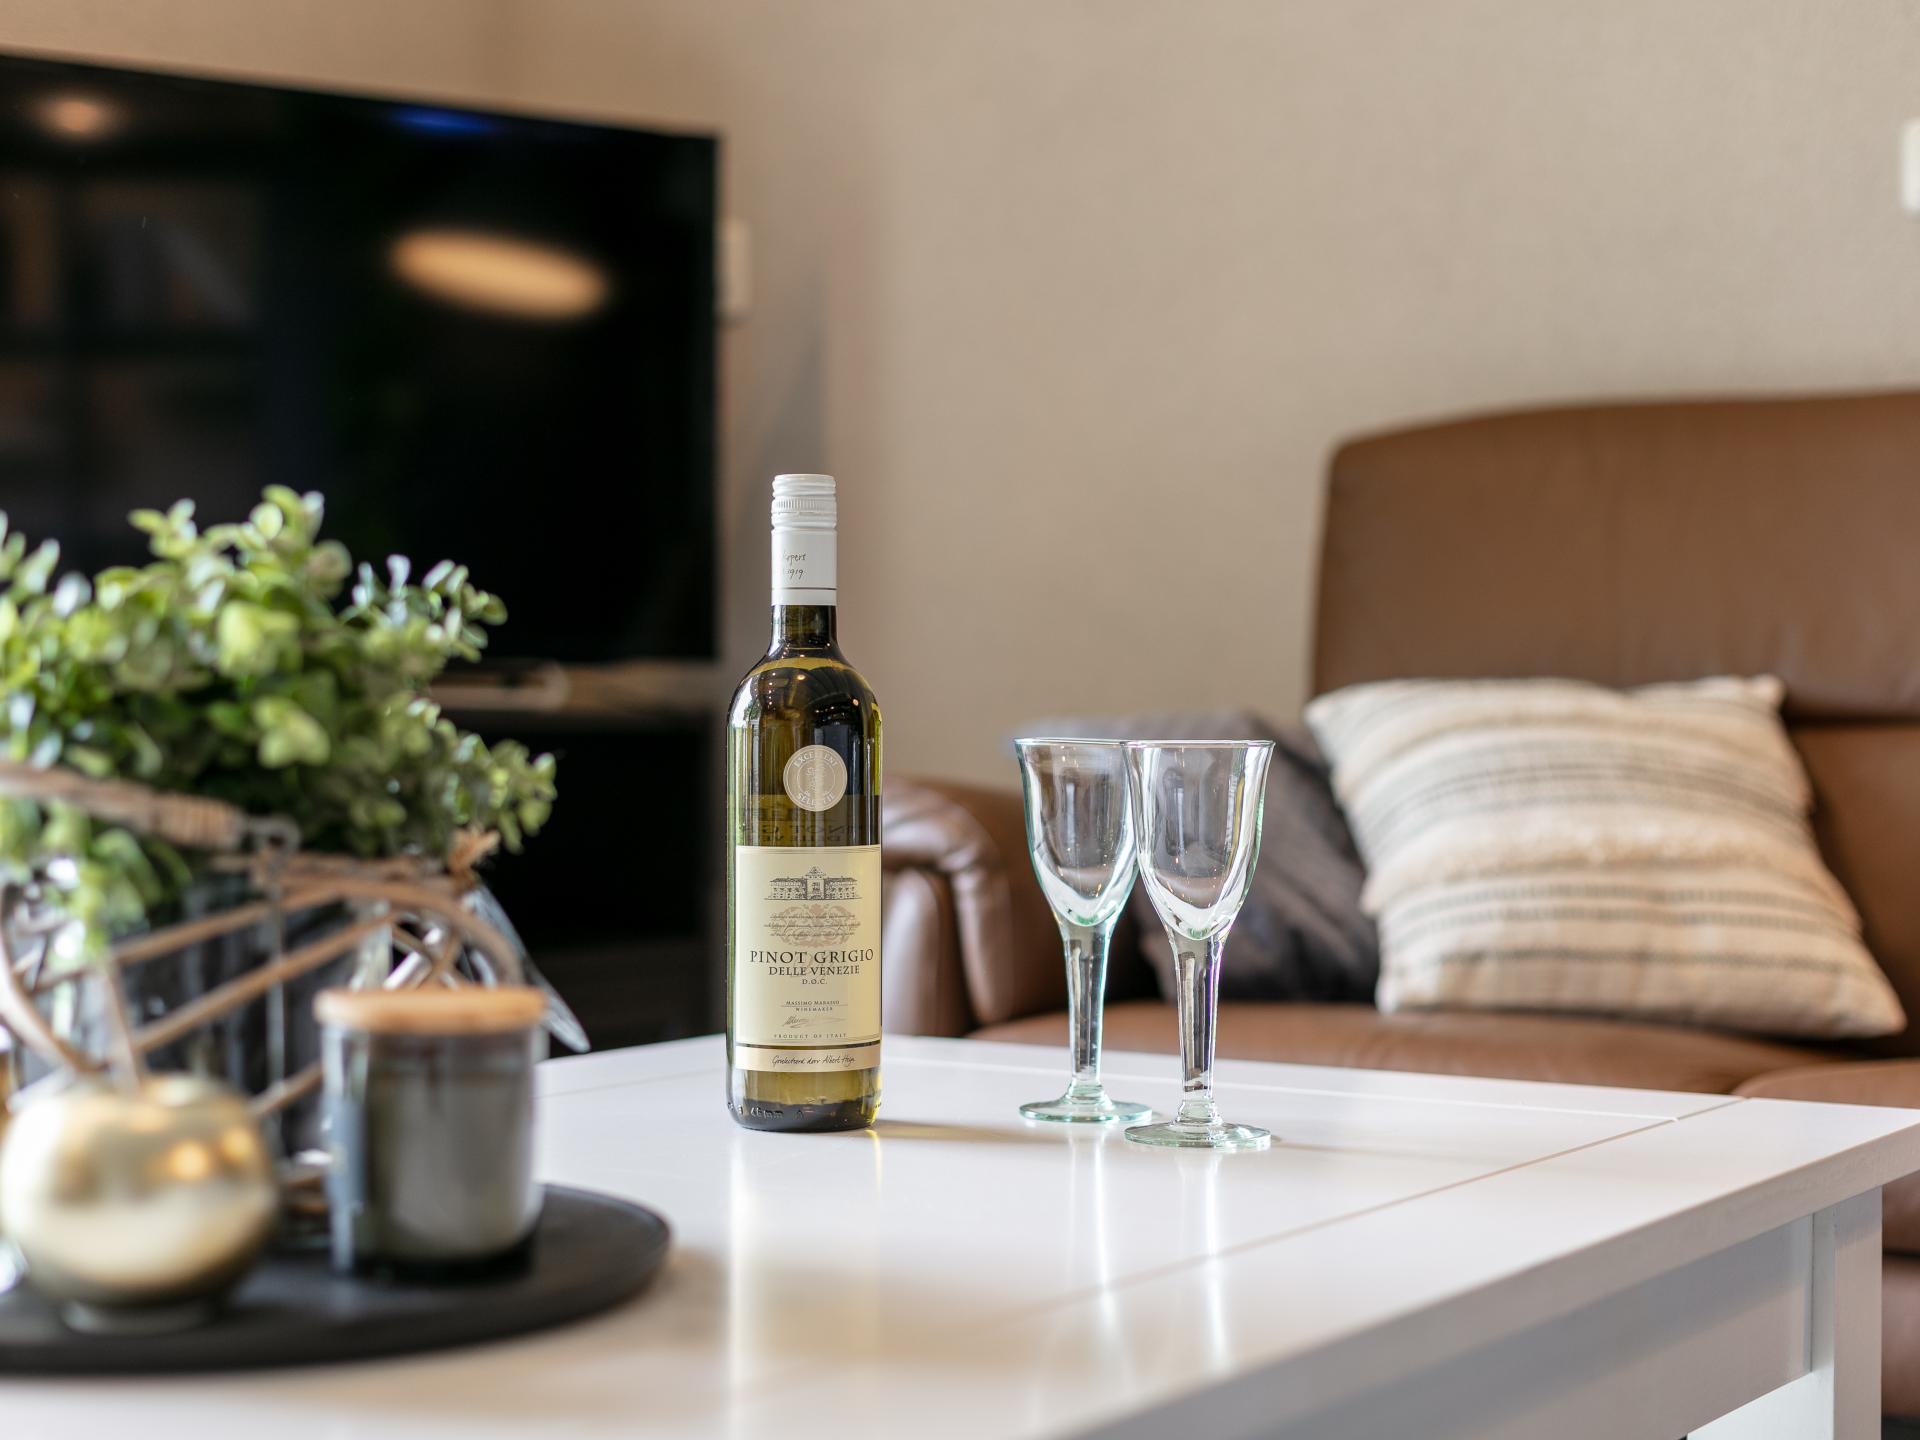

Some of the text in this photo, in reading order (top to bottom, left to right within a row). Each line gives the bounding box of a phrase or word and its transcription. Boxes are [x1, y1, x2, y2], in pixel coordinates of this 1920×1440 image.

[793, 751, 837, 767] EXCEENT
[750, 948, 874, 964] PINOT GRIGIO
[769, 964, 860, 976] DELLE VENEZIE
